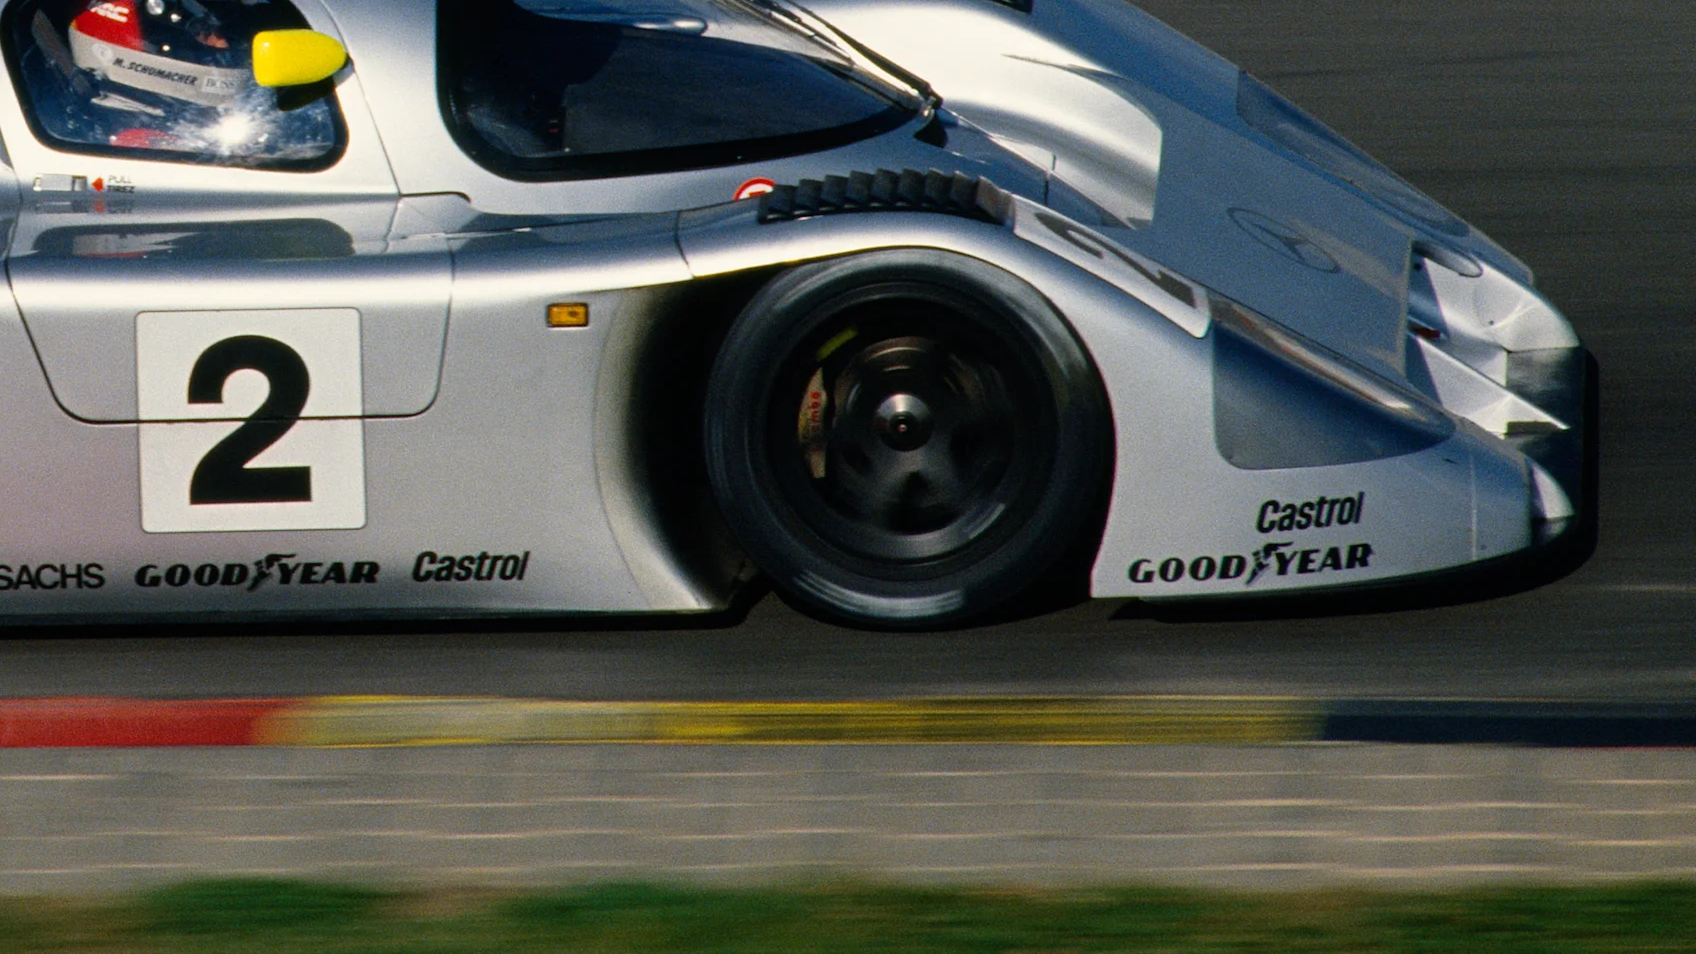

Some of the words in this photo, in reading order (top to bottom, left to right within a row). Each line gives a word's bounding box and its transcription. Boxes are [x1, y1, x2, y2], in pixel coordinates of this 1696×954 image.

[129, 60, 198, 86] SCHUMACHER
[1034, 212, 1197, 309] 2
[187, 334, 312, 505] 2
[1256, 491, 1364, 533] Castrol
[412, 550, 530, 582] Castrol
